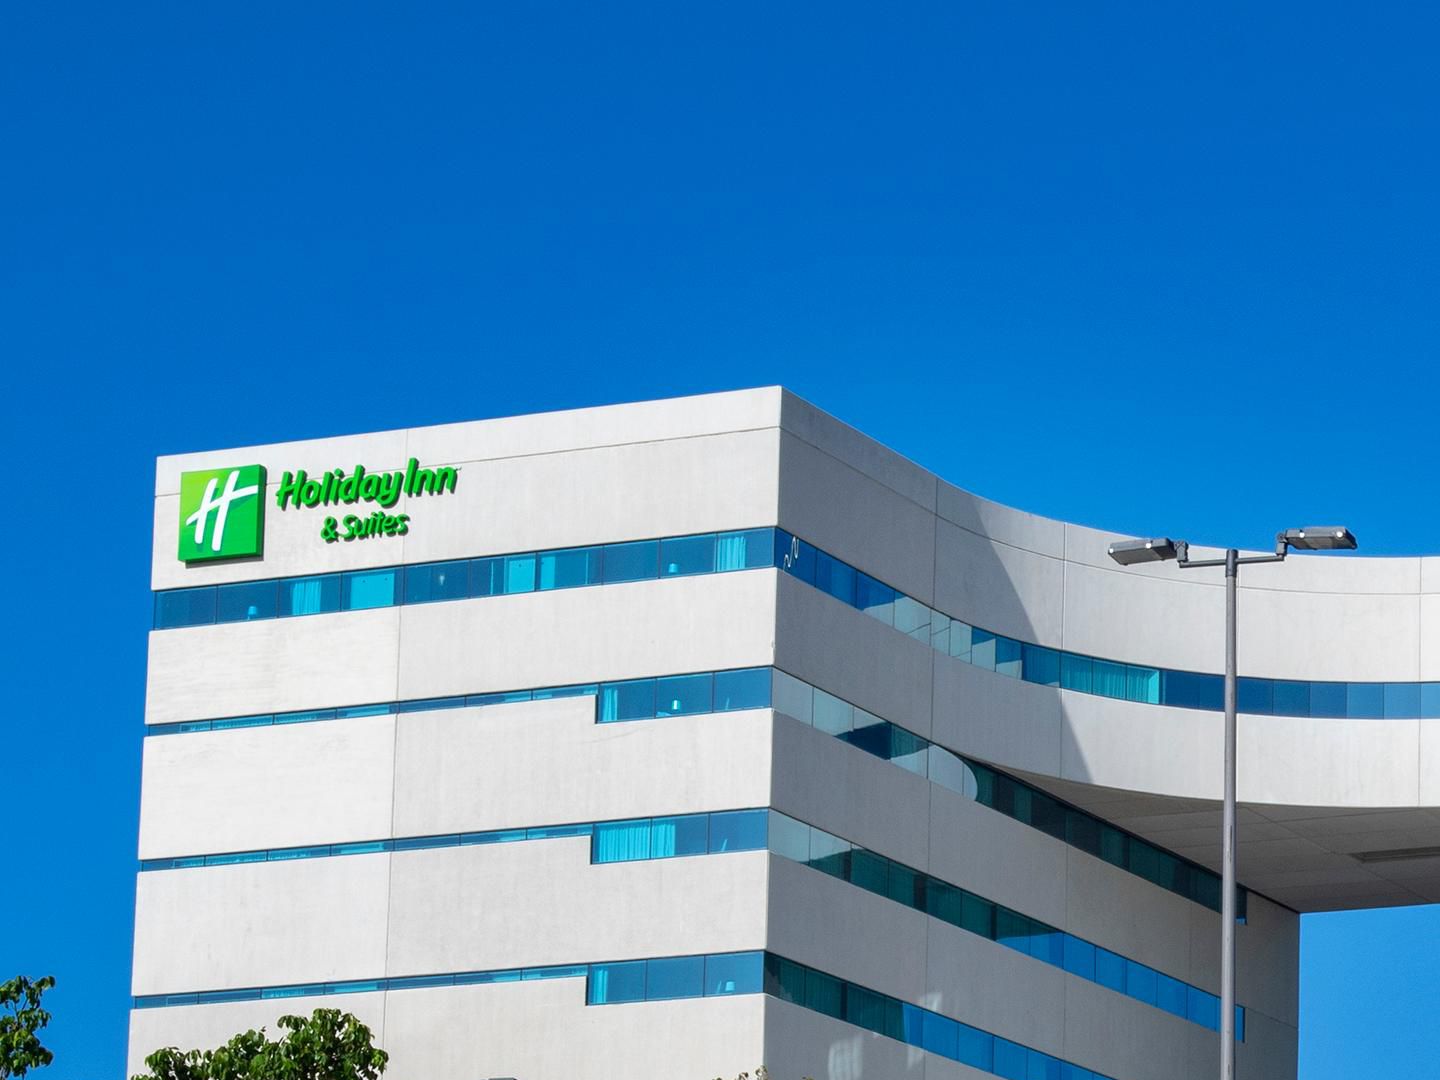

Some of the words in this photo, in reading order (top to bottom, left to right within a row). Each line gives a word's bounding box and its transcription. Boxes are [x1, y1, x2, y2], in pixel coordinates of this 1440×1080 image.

[276, 465, 403, 509] Holiday
[403, 457, 458, 498] Inn
[321, 516, 339, 543] &
[341, 511, 410, 541] Suites
